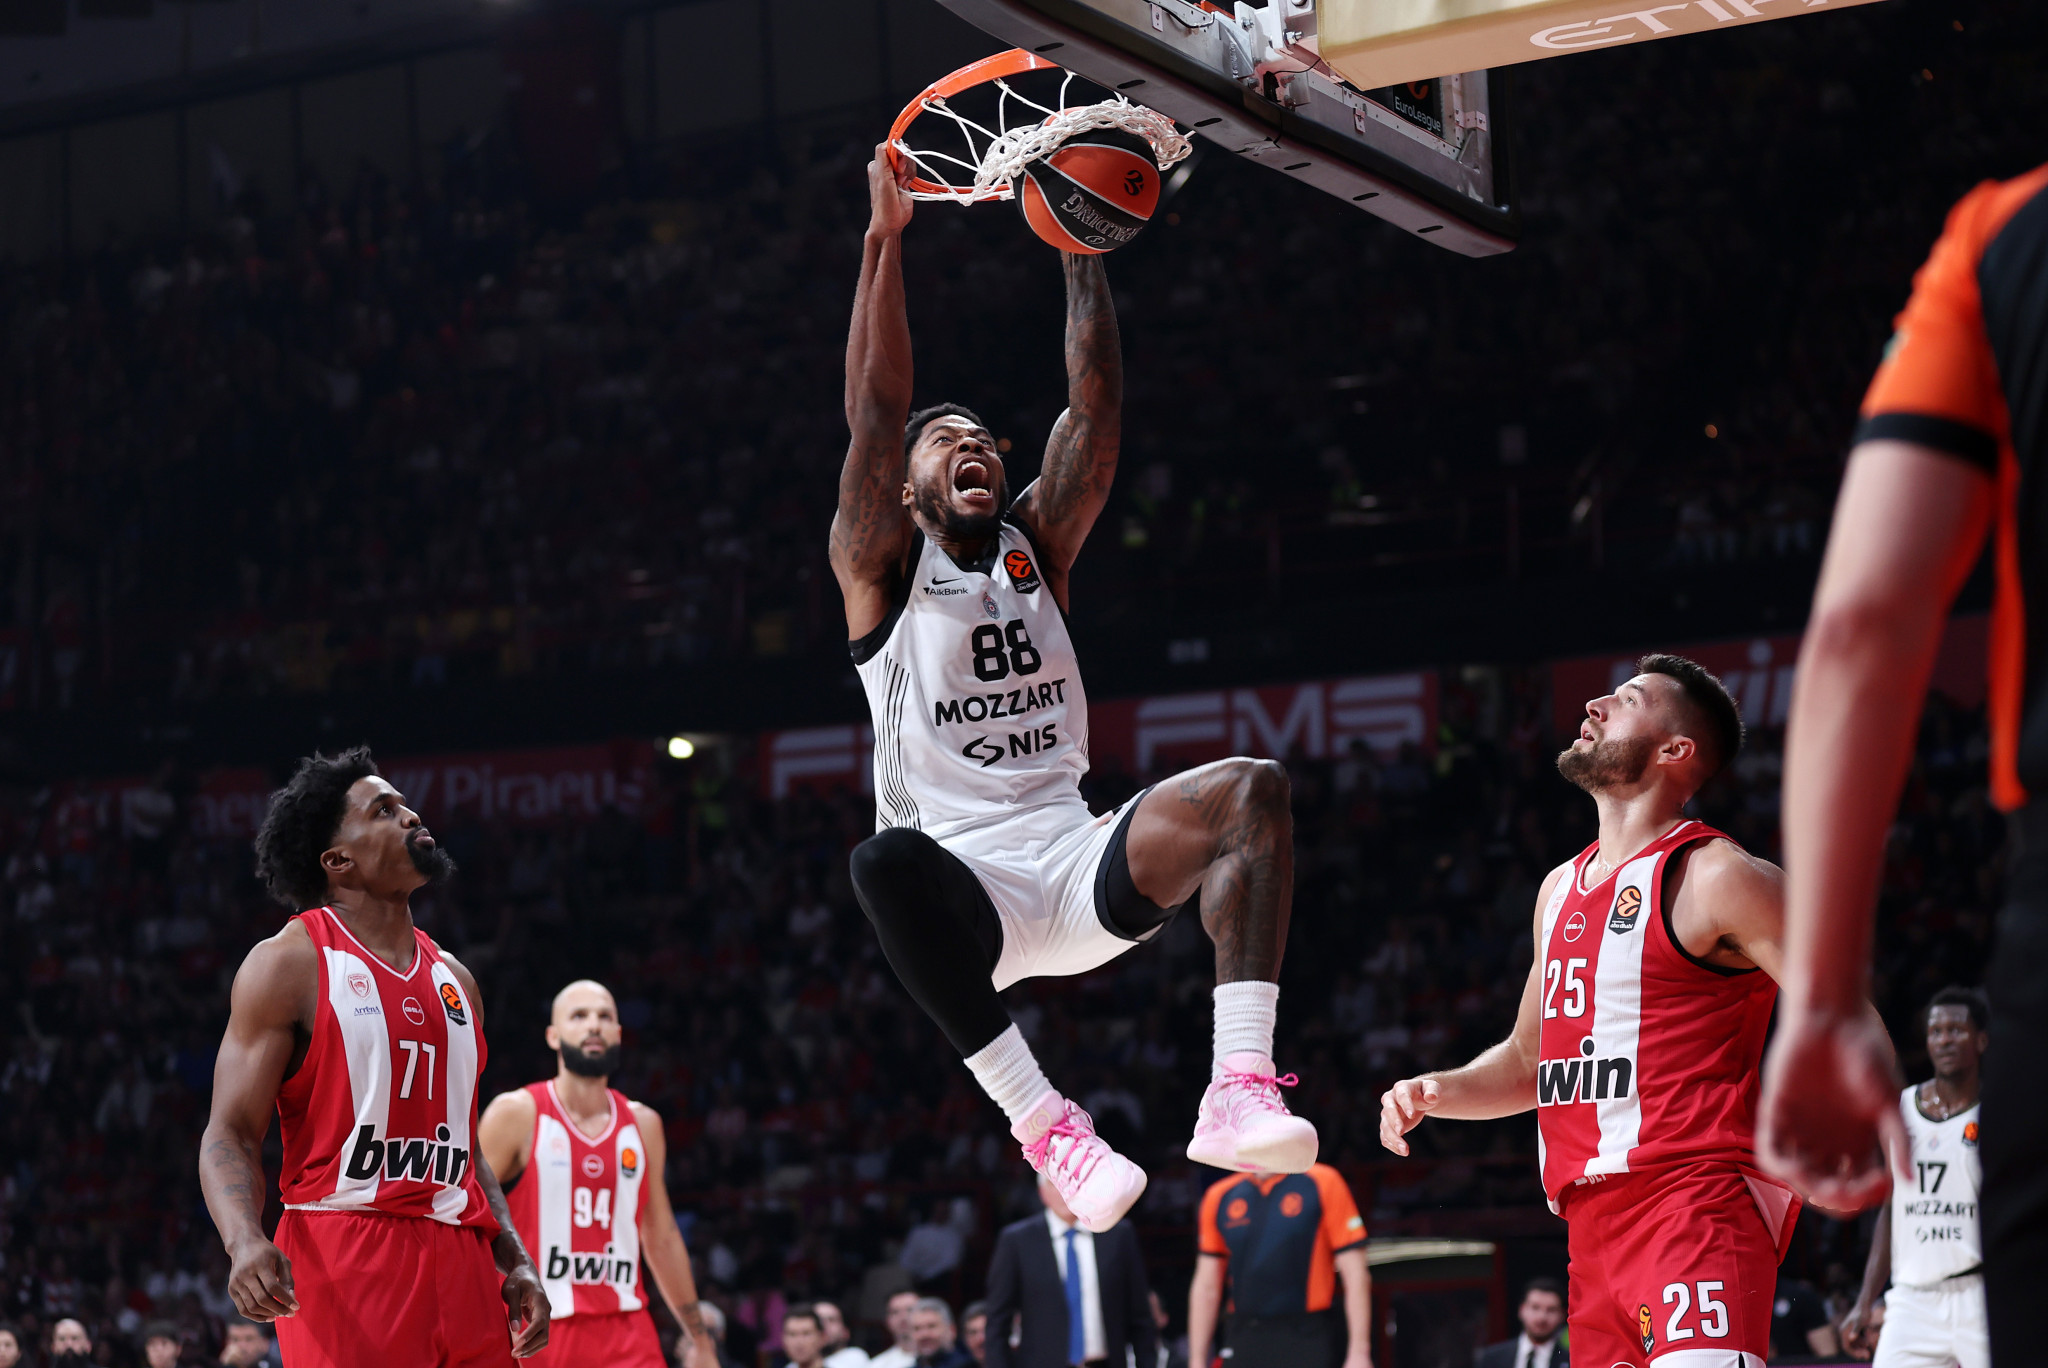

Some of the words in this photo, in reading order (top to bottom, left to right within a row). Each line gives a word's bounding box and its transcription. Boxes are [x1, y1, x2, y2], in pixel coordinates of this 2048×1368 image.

[1394, 95, 1442, 131] EuroLeague
[971, 618, 1042, 683] 88
[935, 678, 1066, 727] MOZZART
[1134, 675, 1426, 773] FMS
[1008, 723, 1058, 758] NIS
[1544, 957, 1589, 1020] 25
[399, 1039, 436, 1101] 71
[1538, 1037, 1633, 1106] win
[344, 1123, 470, 1188] bwin
[1917, 1160, 1948, 1194] 17
[573, 1186, 612, 1229] 94
[1905, 1201, 1977, 1219] MOZZART
[1931, 1226, 1963, 1241] NIS
[546, 1244, 634, 1285] bwin
[1662, 1280, 1730, 1343] 25
